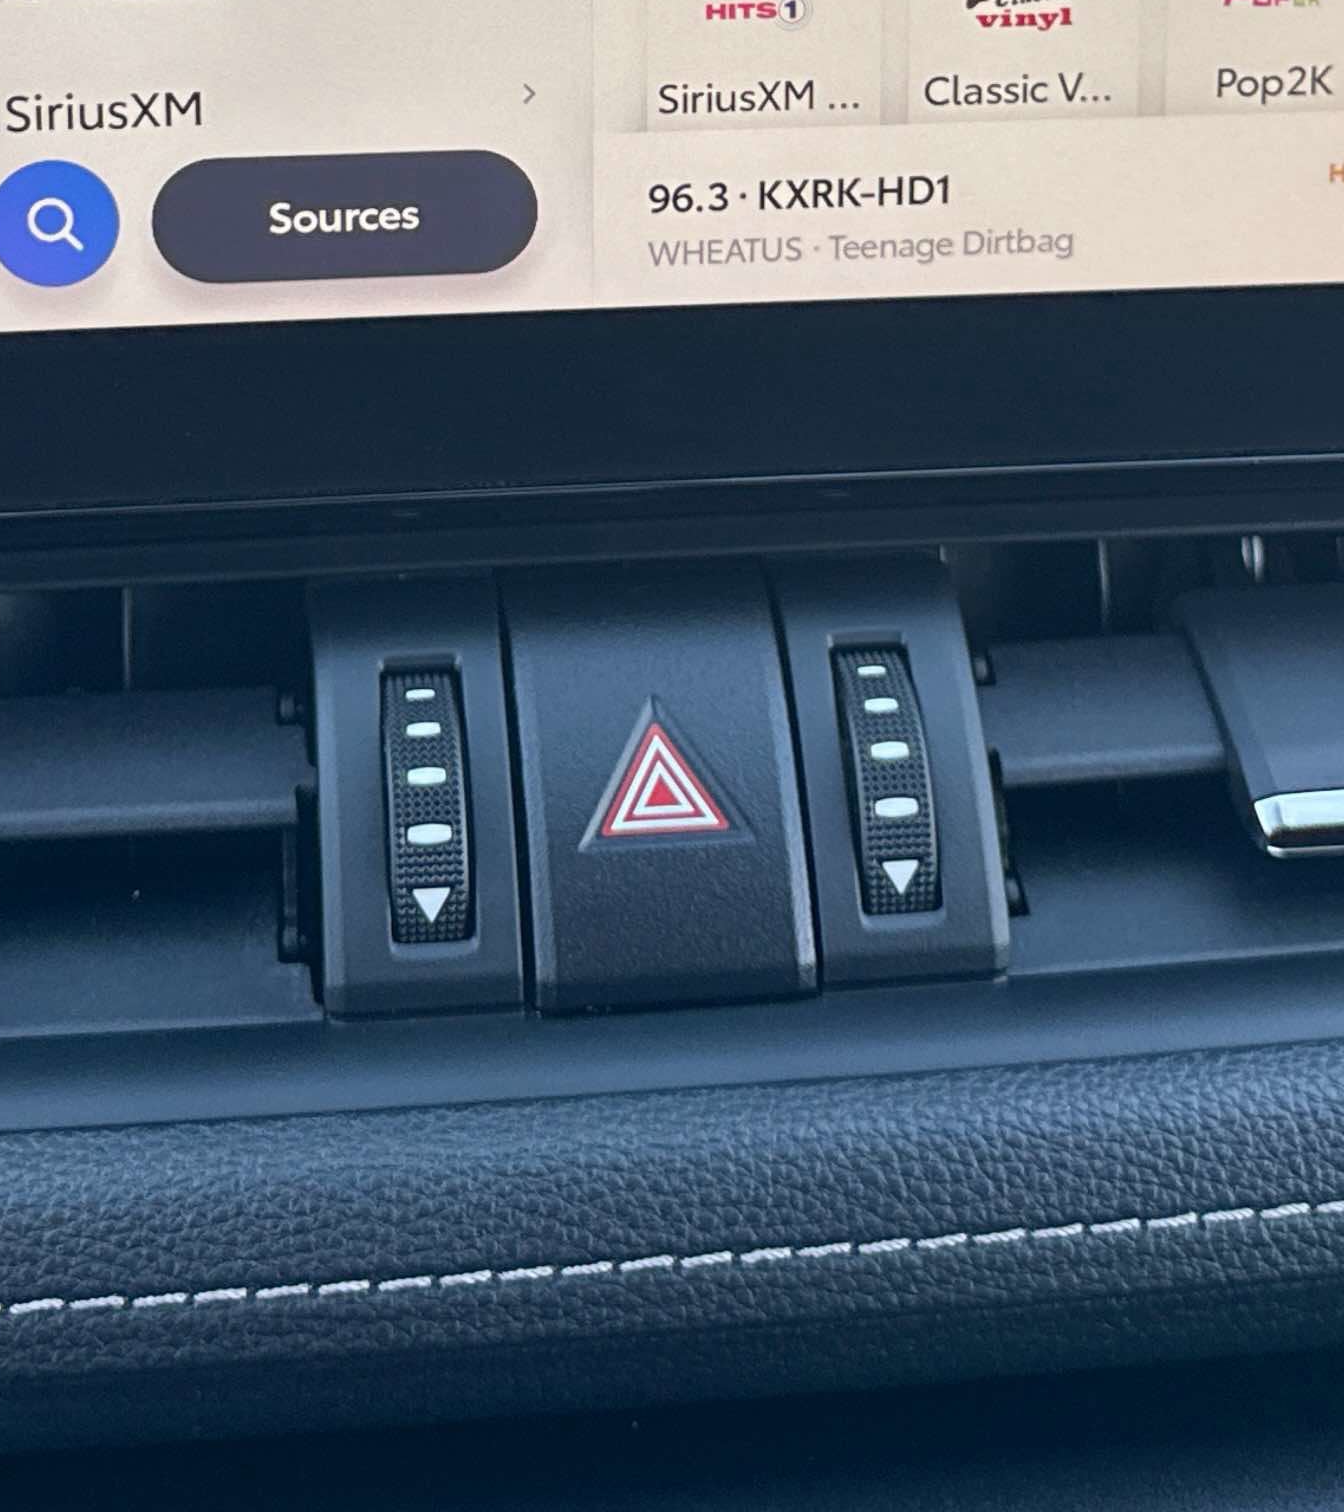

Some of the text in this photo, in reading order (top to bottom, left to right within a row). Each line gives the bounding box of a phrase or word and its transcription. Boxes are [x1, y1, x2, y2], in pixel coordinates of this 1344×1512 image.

[705, 1, 777, 20] HITS
[975, 7, 1073, 31] vinyl
[658, 79, 814, 114] SiriusXM
[924, 72, 1111, 106] Classic V...
[1216, 65, 1333, 105] Pop2K
[6, 91, 202, 133] SiriusXM
[648, 182, 729, 214] 96.3
[759, 175, 949, 211] KXRK-HD1
[269, 202, 420, 234] Sources
[647, 236, 802, 267] WHEATUS
[828, 234, 954, 265] Teenage
[963, 227, 1074, 260] Dirtbag
